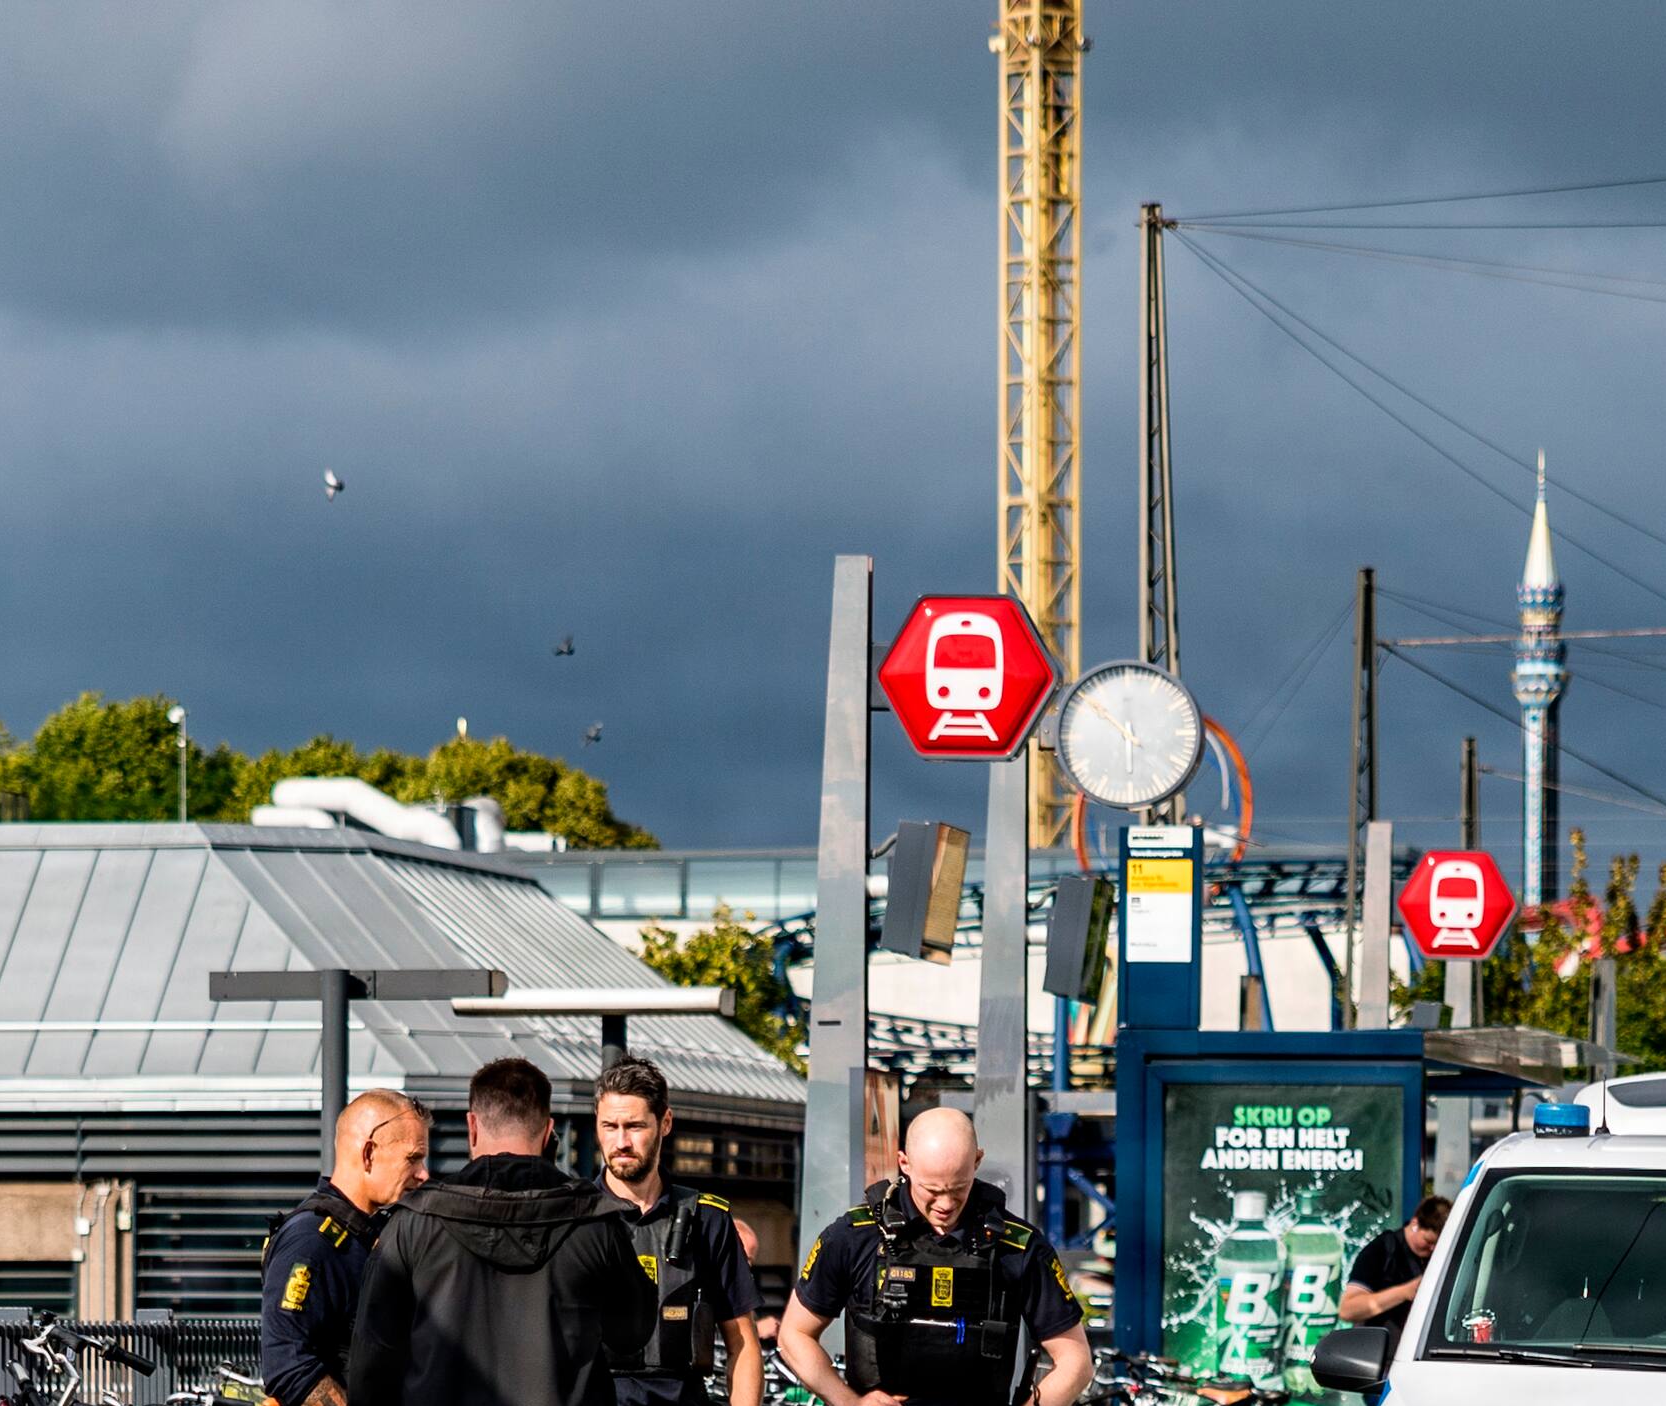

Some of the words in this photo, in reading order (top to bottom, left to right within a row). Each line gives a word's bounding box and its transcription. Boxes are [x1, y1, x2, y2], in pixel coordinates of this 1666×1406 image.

[1234, 1106, 1293, 1127] SKRU
[1297, 1107, 1332, 1127] OP
[1215, 1126, 1262, 1148] FOR
[1265, 1127, 1295, 1148] EN
[1298, 1128, 1350, 1149] HELT
[1200, 1148, 1279, 1170] ANDEN
[1282, 1149, 1364, 1171] ENERGI
